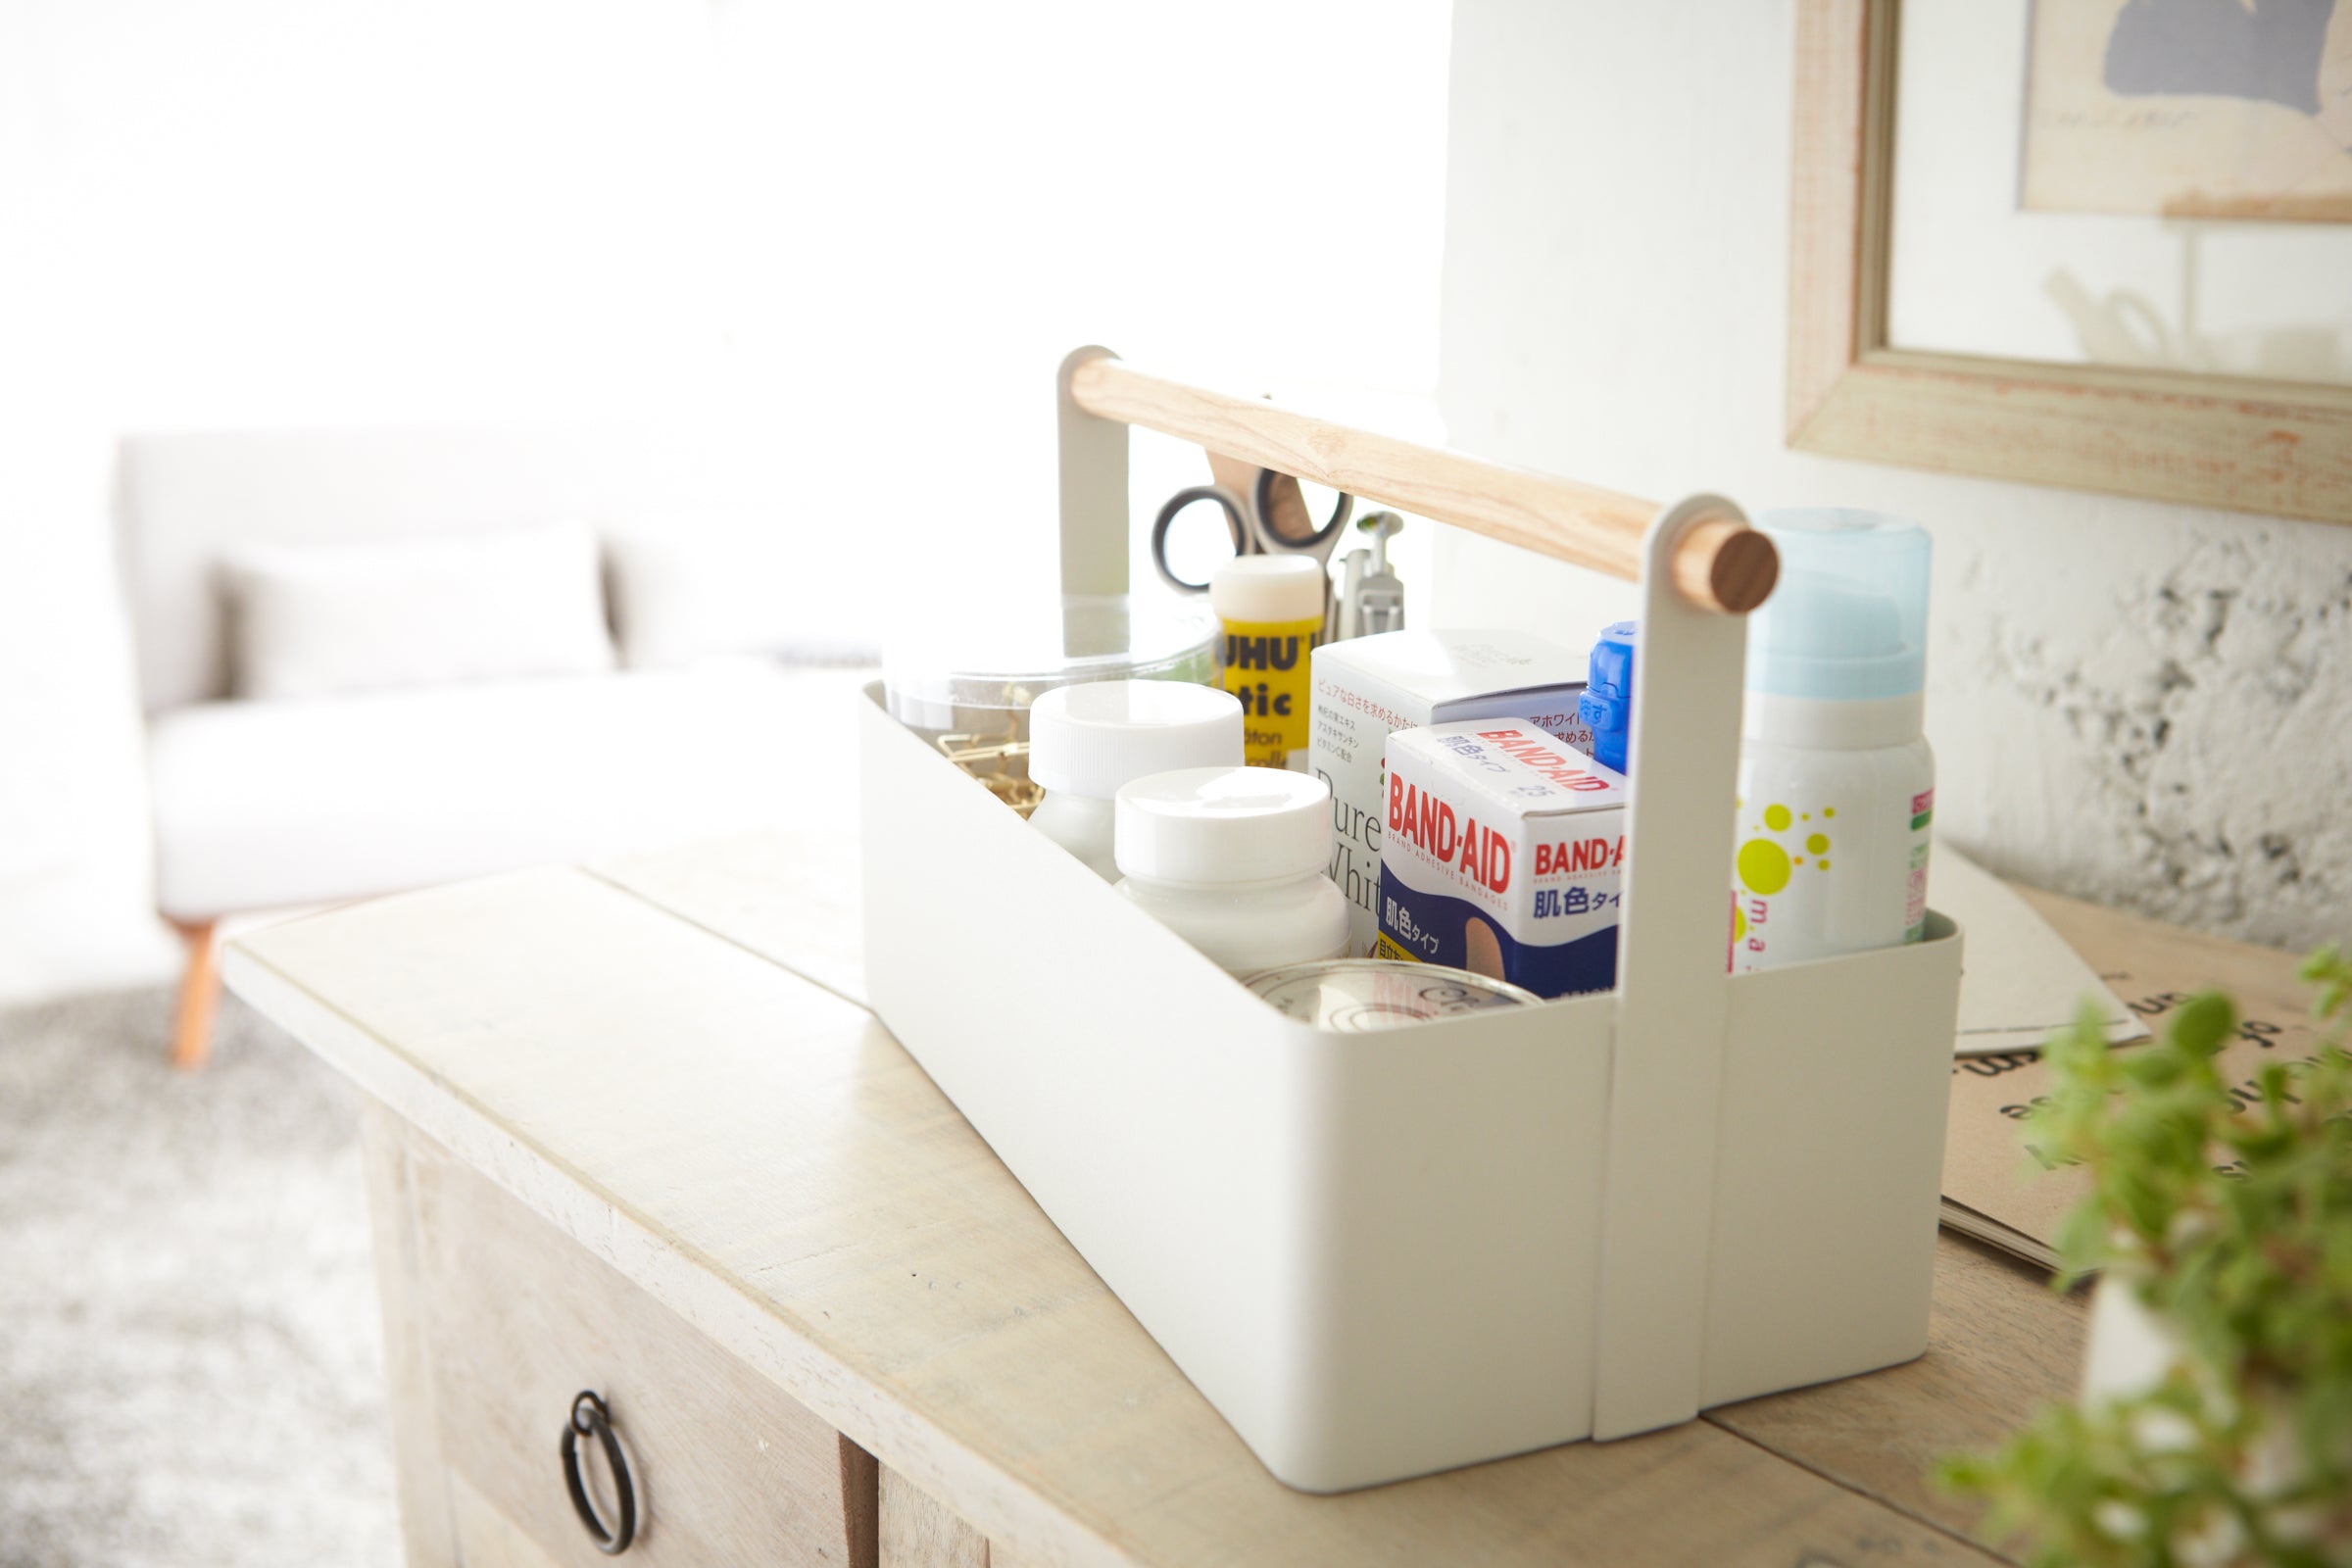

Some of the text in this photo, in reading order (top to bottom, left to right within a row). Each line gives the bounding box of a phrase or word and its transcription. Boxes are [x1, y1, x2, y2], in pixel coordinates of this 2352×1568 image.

[1216, 634, 1298, 671] UHU
[1227, 683, 1292, 716] tic
[1477, 730, 1610, 792] BAND-AID
[1389, 771, 1511, 895] BAND-AID
[1388, 831, 1508, 910] BRAND ADHESIVE BANDAGES
[1386, 896, 1440, 955] 肌色タイプ
